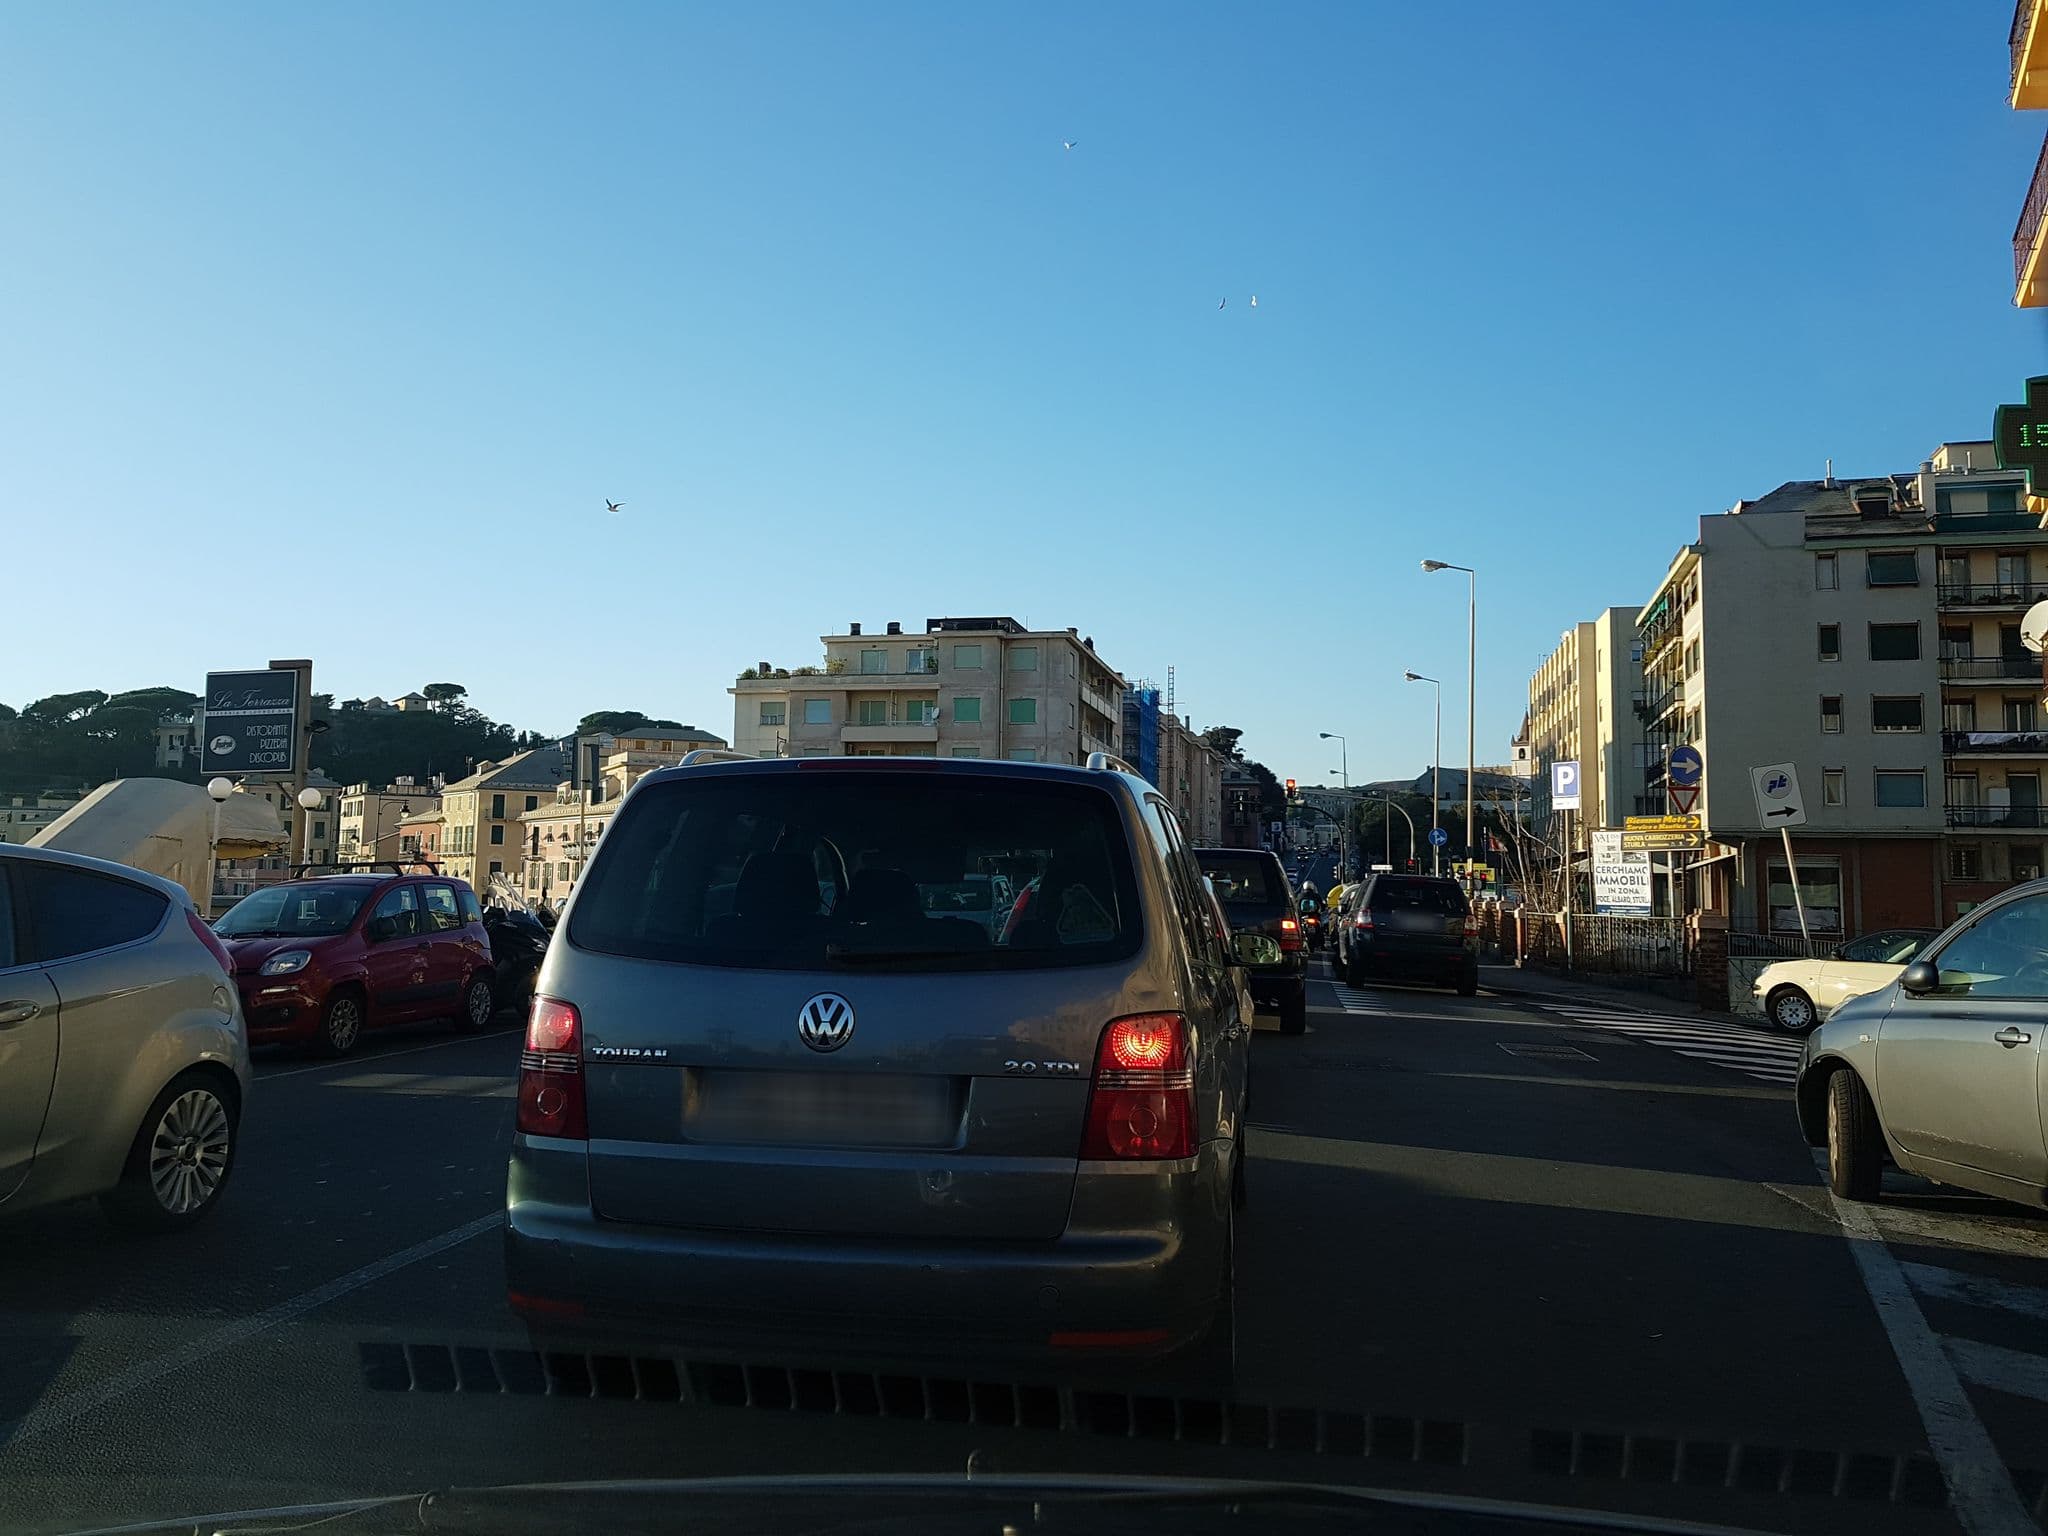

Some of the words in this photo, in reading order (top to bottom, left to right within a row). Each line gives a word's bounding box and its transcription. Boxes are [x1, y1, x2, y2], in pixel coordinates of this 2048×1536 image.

[209, 690, 232, 708] La
[235, 689, 289, 708] Terrazza
[246, 725, 289, 736] RISTORANTE
[260, 738, 288, 749] PIZZERIA
[249, 752, 287, 763] DISCOPUB
[1557, 766, 1575, 794] P
[1663, 815, 1687, 823] Moto
[592, 1046, 668, 1057] TOURAN
[1043, 1061, 1080, 1073] TDI
